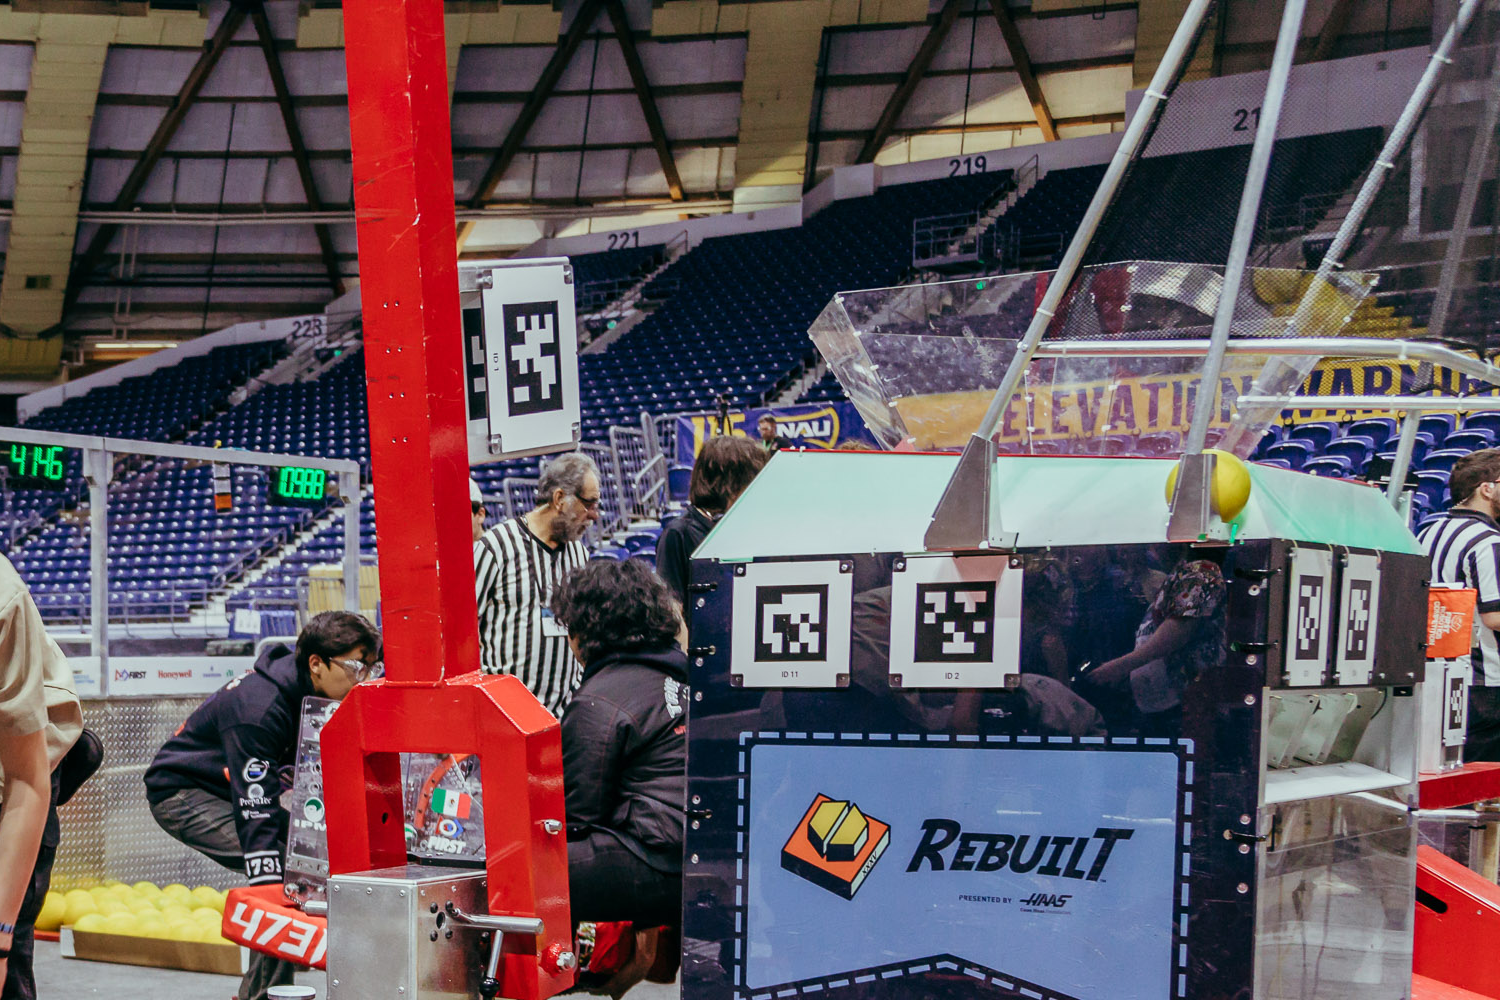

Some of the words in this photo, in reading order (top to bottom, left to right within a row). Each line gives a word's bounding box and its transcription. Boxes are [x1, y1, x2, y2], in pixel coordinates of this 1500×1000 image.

[1233, 107, 1261, 131] 21
[949, 155, 987, 177] 219
[608, 231, 639, 249] 221
[292, 319, 322, 338] 223
[776, 420, 831, 438] NAU
[11, 445, 63, 480] 4146
[279, 466, 325, 500] 10988
[129, 671, 147, 679] FIRST
[158, 669, 192, 680] Honeywell
[428, 836, 467, 854] FIRST
[905, 818, 1135, 882] REBUILT
[959, 894, 1000, 903] PRESENTED
[1020, 893, 1072, 907] HAAS
[231, 902, 327, 965] 4731
